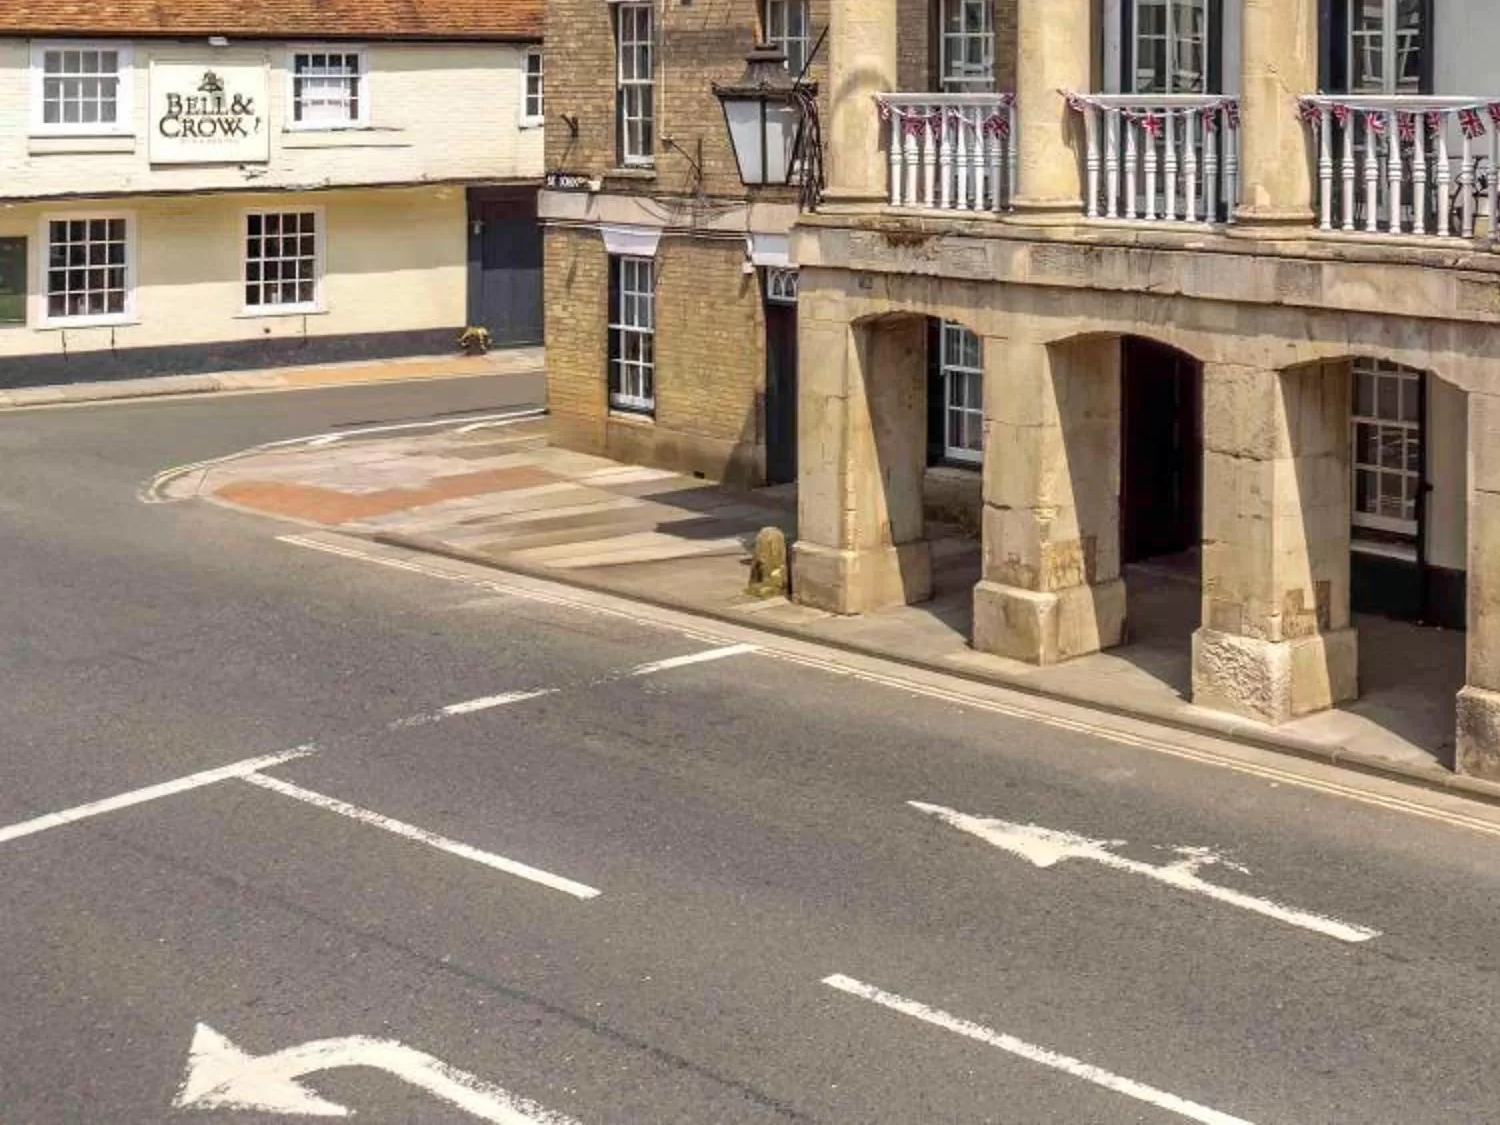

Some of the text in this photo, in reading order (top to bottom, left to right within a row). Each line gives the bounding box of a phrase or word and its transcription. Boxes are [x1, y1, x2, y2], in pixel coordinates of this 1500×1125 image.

[166, 92, 254, 116] BELL &
[159, 114, 248, 138] CROW
